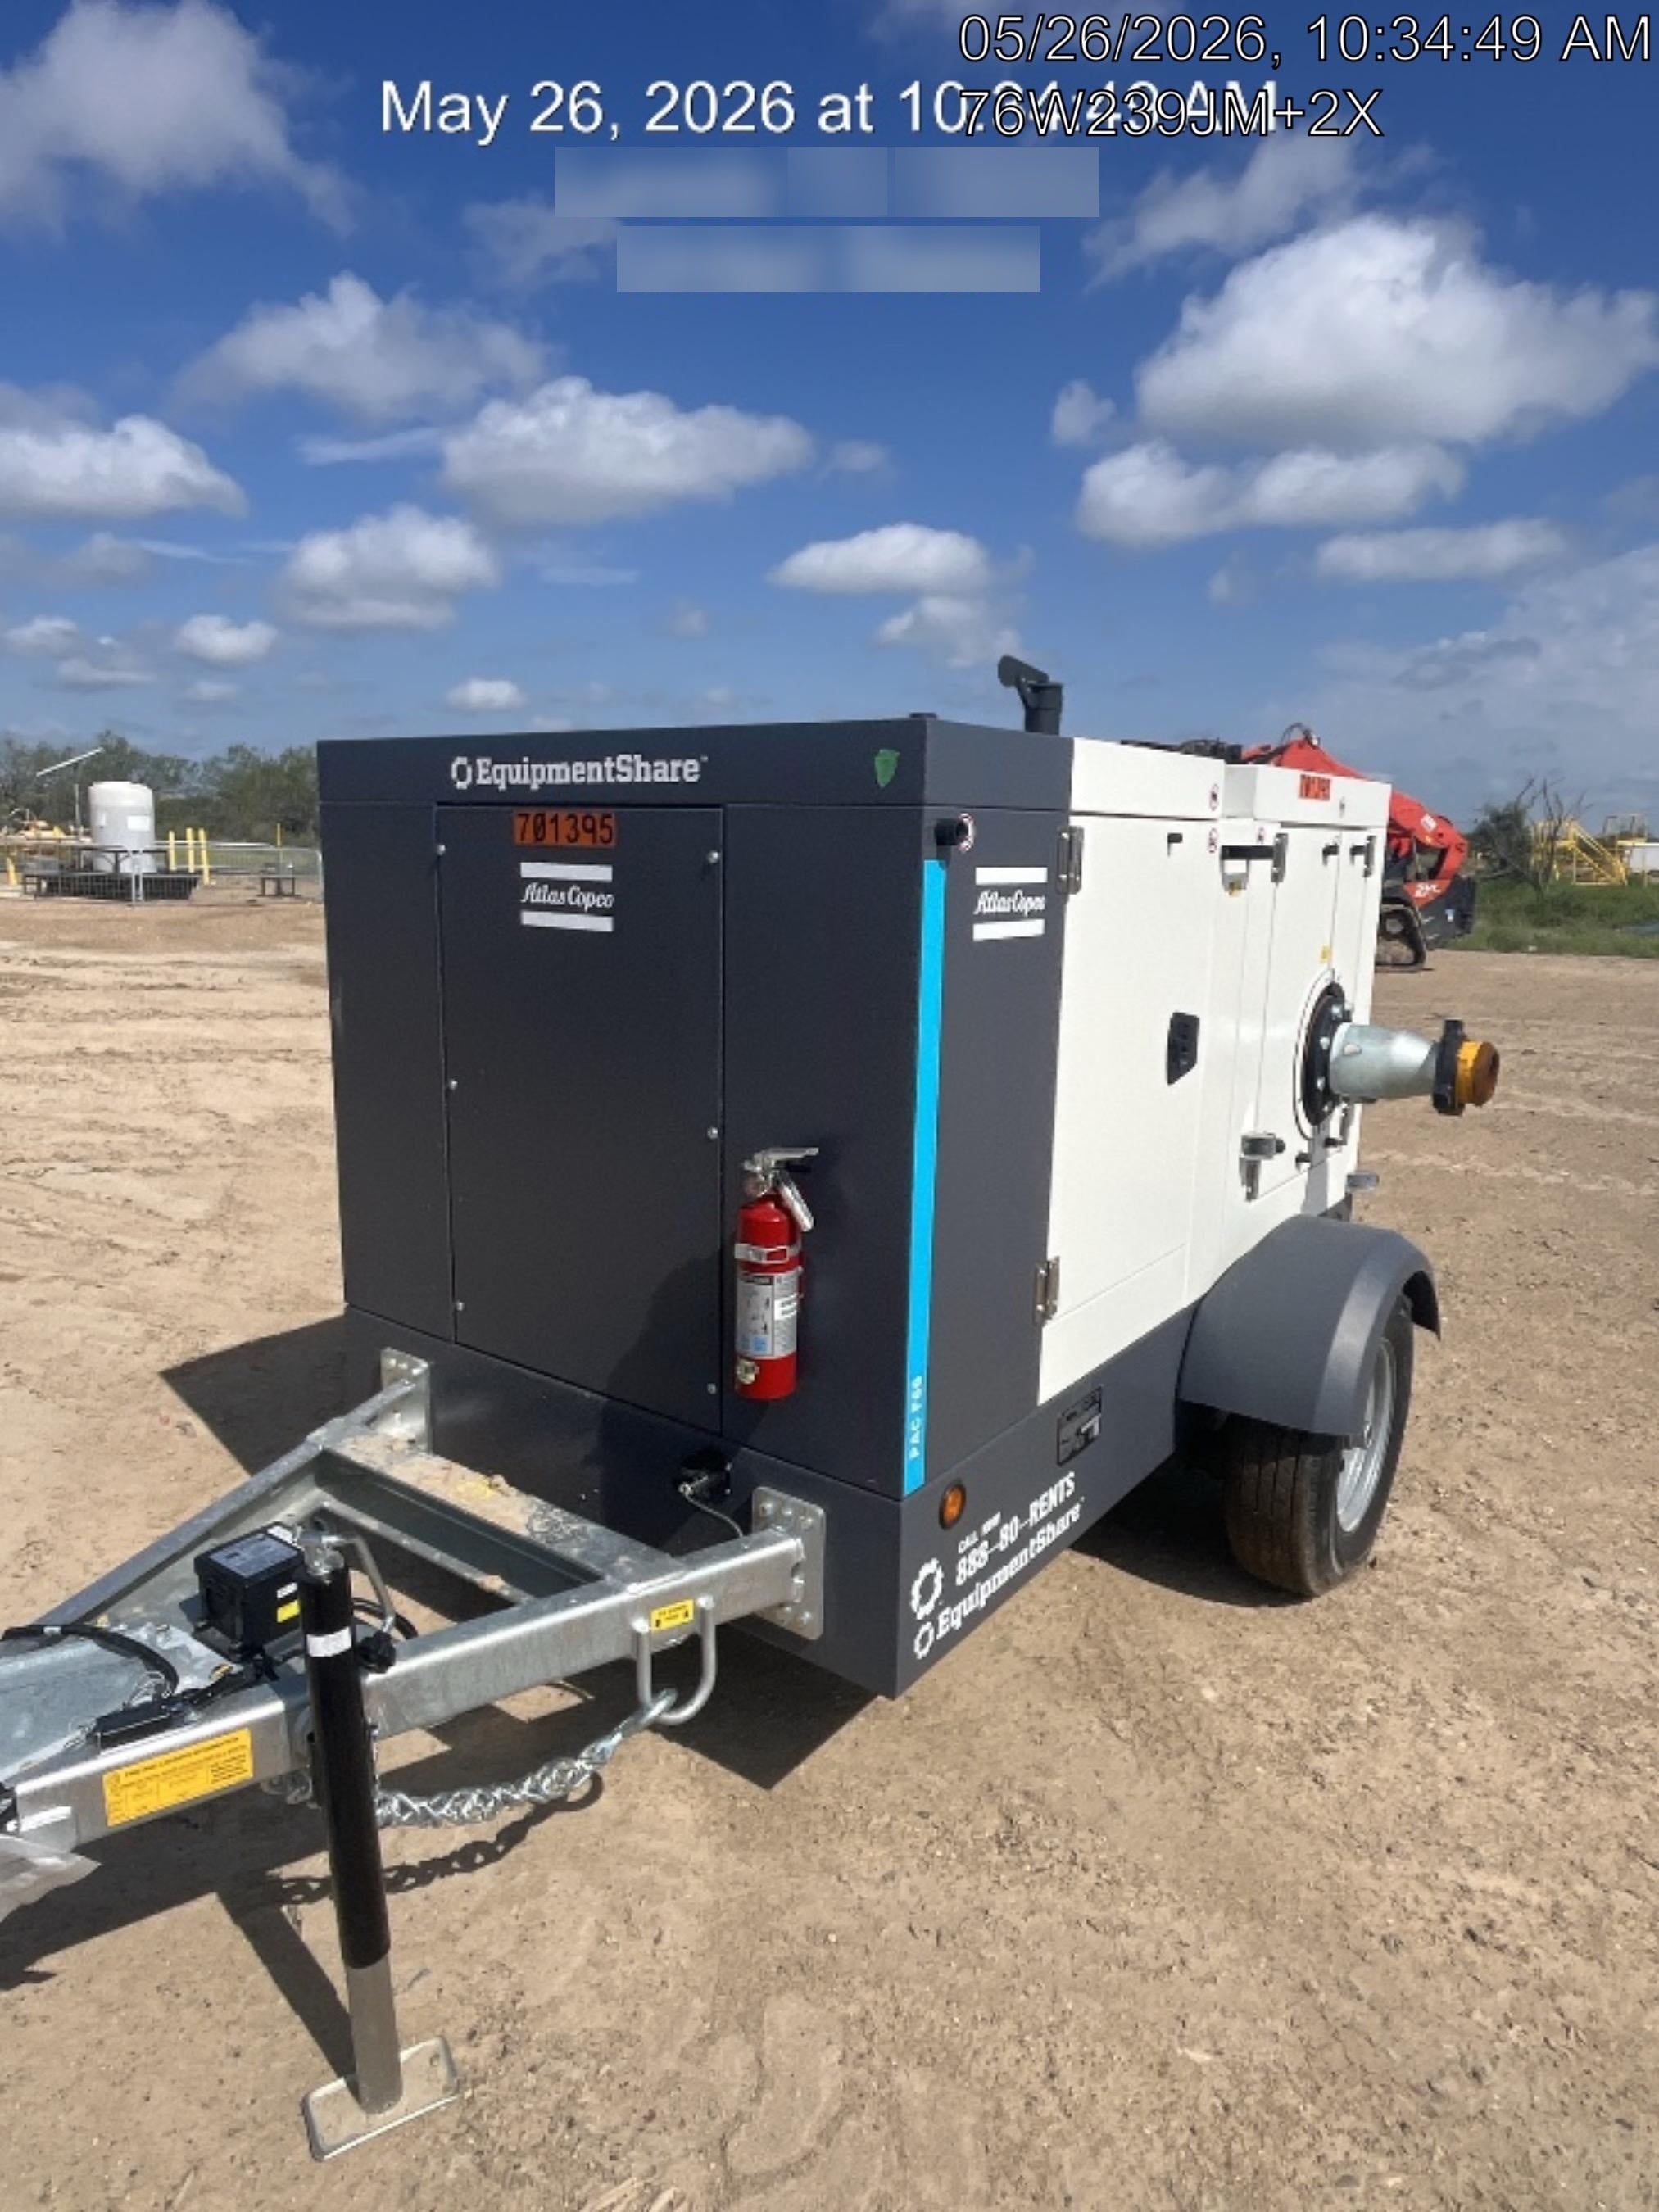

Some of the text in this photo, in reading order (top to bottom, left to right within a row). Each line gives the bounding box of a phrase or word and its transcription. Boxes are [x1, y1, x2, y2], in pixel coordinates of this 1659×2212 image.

[475, 754, 701, 791] EquipmentShare
[517, 812, 614, 845] 701395
[520, 882, 614, 913] Atlas Copco
